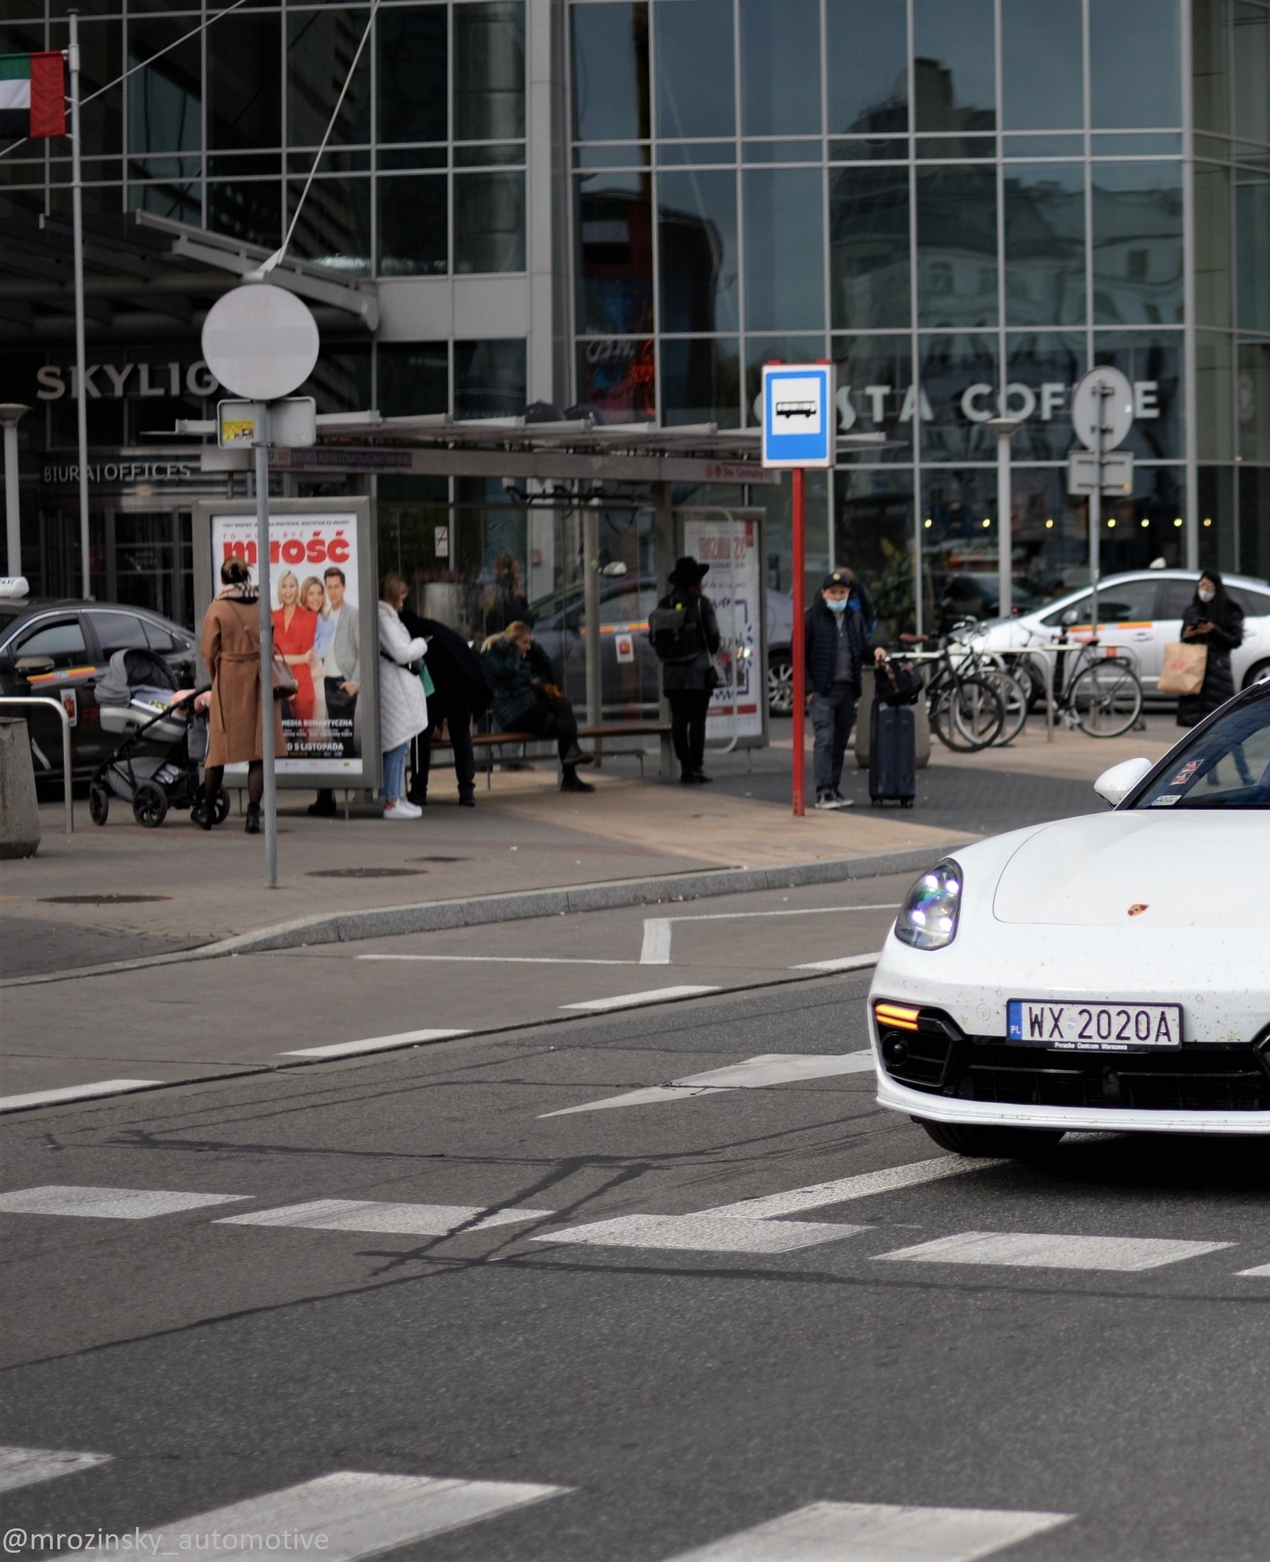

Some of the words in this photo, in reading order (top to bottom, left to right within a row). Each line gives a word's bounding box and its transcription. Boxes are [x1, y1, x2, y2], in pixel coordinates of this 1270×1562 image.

[36, 360, 220, 400] SKYLIG
[961, 381, 1161, 422] COFE
[300, 742, 344, 751] LISTOPADA
[1010, 1025, 1021, 1035] PL
[1029, 1006, 1065, 1039] WX
[1078, 1008, 1172, 1042] 2020A
[1101, 1043, 1128, 1051] Warszawa
